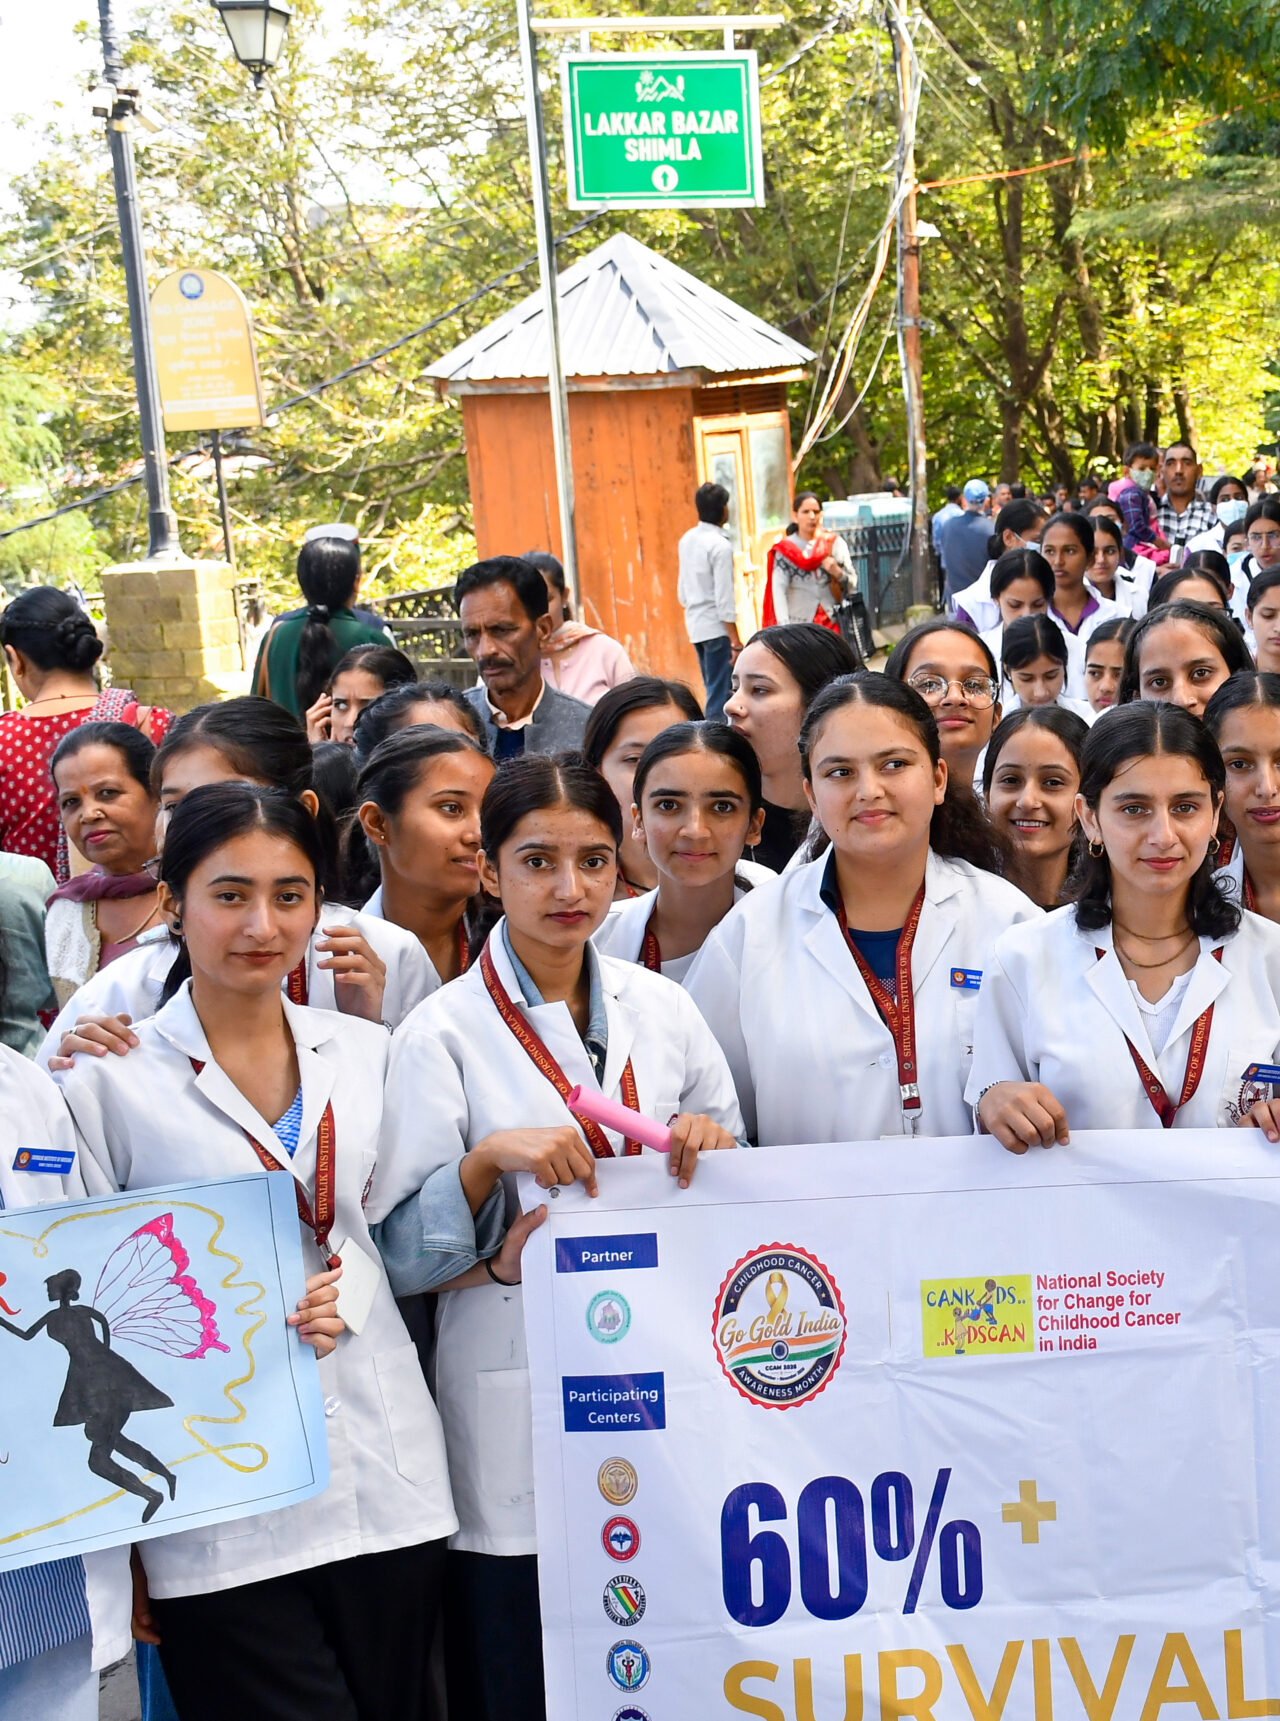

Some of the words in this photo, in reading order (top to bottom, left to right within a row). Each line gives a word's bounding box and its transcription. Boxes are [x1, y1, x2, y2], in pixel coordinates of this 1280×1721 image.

[584, 111, 666, 135] LAKKAR
[672, 110, 739, 135] BAZAR
[624, 137, 702, 161] SHIMLA
[899, 921, 916, 955] NURSING
[899, 956, 906, 966] OF
[900, 968, 909, 1012] INSTITUTE
[505, 1013, 531, 1044] KAMLA
[902, 1015, 911, 1056] SHIVALIK
[1192, 1015, 1207, 1055] NURSING
[528, 1042, 559, 1082] NURSING
[1189, 1056, 1200, 1070] OF
[319, 1121, 329, 1171] INSTITUTE
[319, 1172, 328, 1221] SHIVALIK
[582, 1251, 633, 1263] Partner
[734, 1257, 785, 1293] CHILDHOOD
[788, 1259, 823, 1290] CANCER
[1036, 1272, 1101, 1290] National
[1106, 1270, 1165, 1288] Society
[1037, 1295, 1059, 1310] for
[1064, 1293, 1124, 1313] Change
[1129, 1291, 1151, 1305] for
[719, 1318, 746, 1353] Go
[750, 1311, 793, 1344] Gold
[795, 1310, 841, 1337] India
[1038, 1312, 1120, 1331] Childhood
[1125, 1311, 1181, 1327] Cancer
[1040, 1337, 1054, 1351] in
[1058, 1335, 1097, 1351] India
[569, 1388, 659, 1404] Participating
[738, 1370, 793, 1397] AWARENESS
[795, 1364, 824, 1394] MONTH
[588, 1411, 641, 1424] Centers
[720, 1467, 983, 1627] 60%
[722, 1629, 1280, 1721] SURVIVAL
